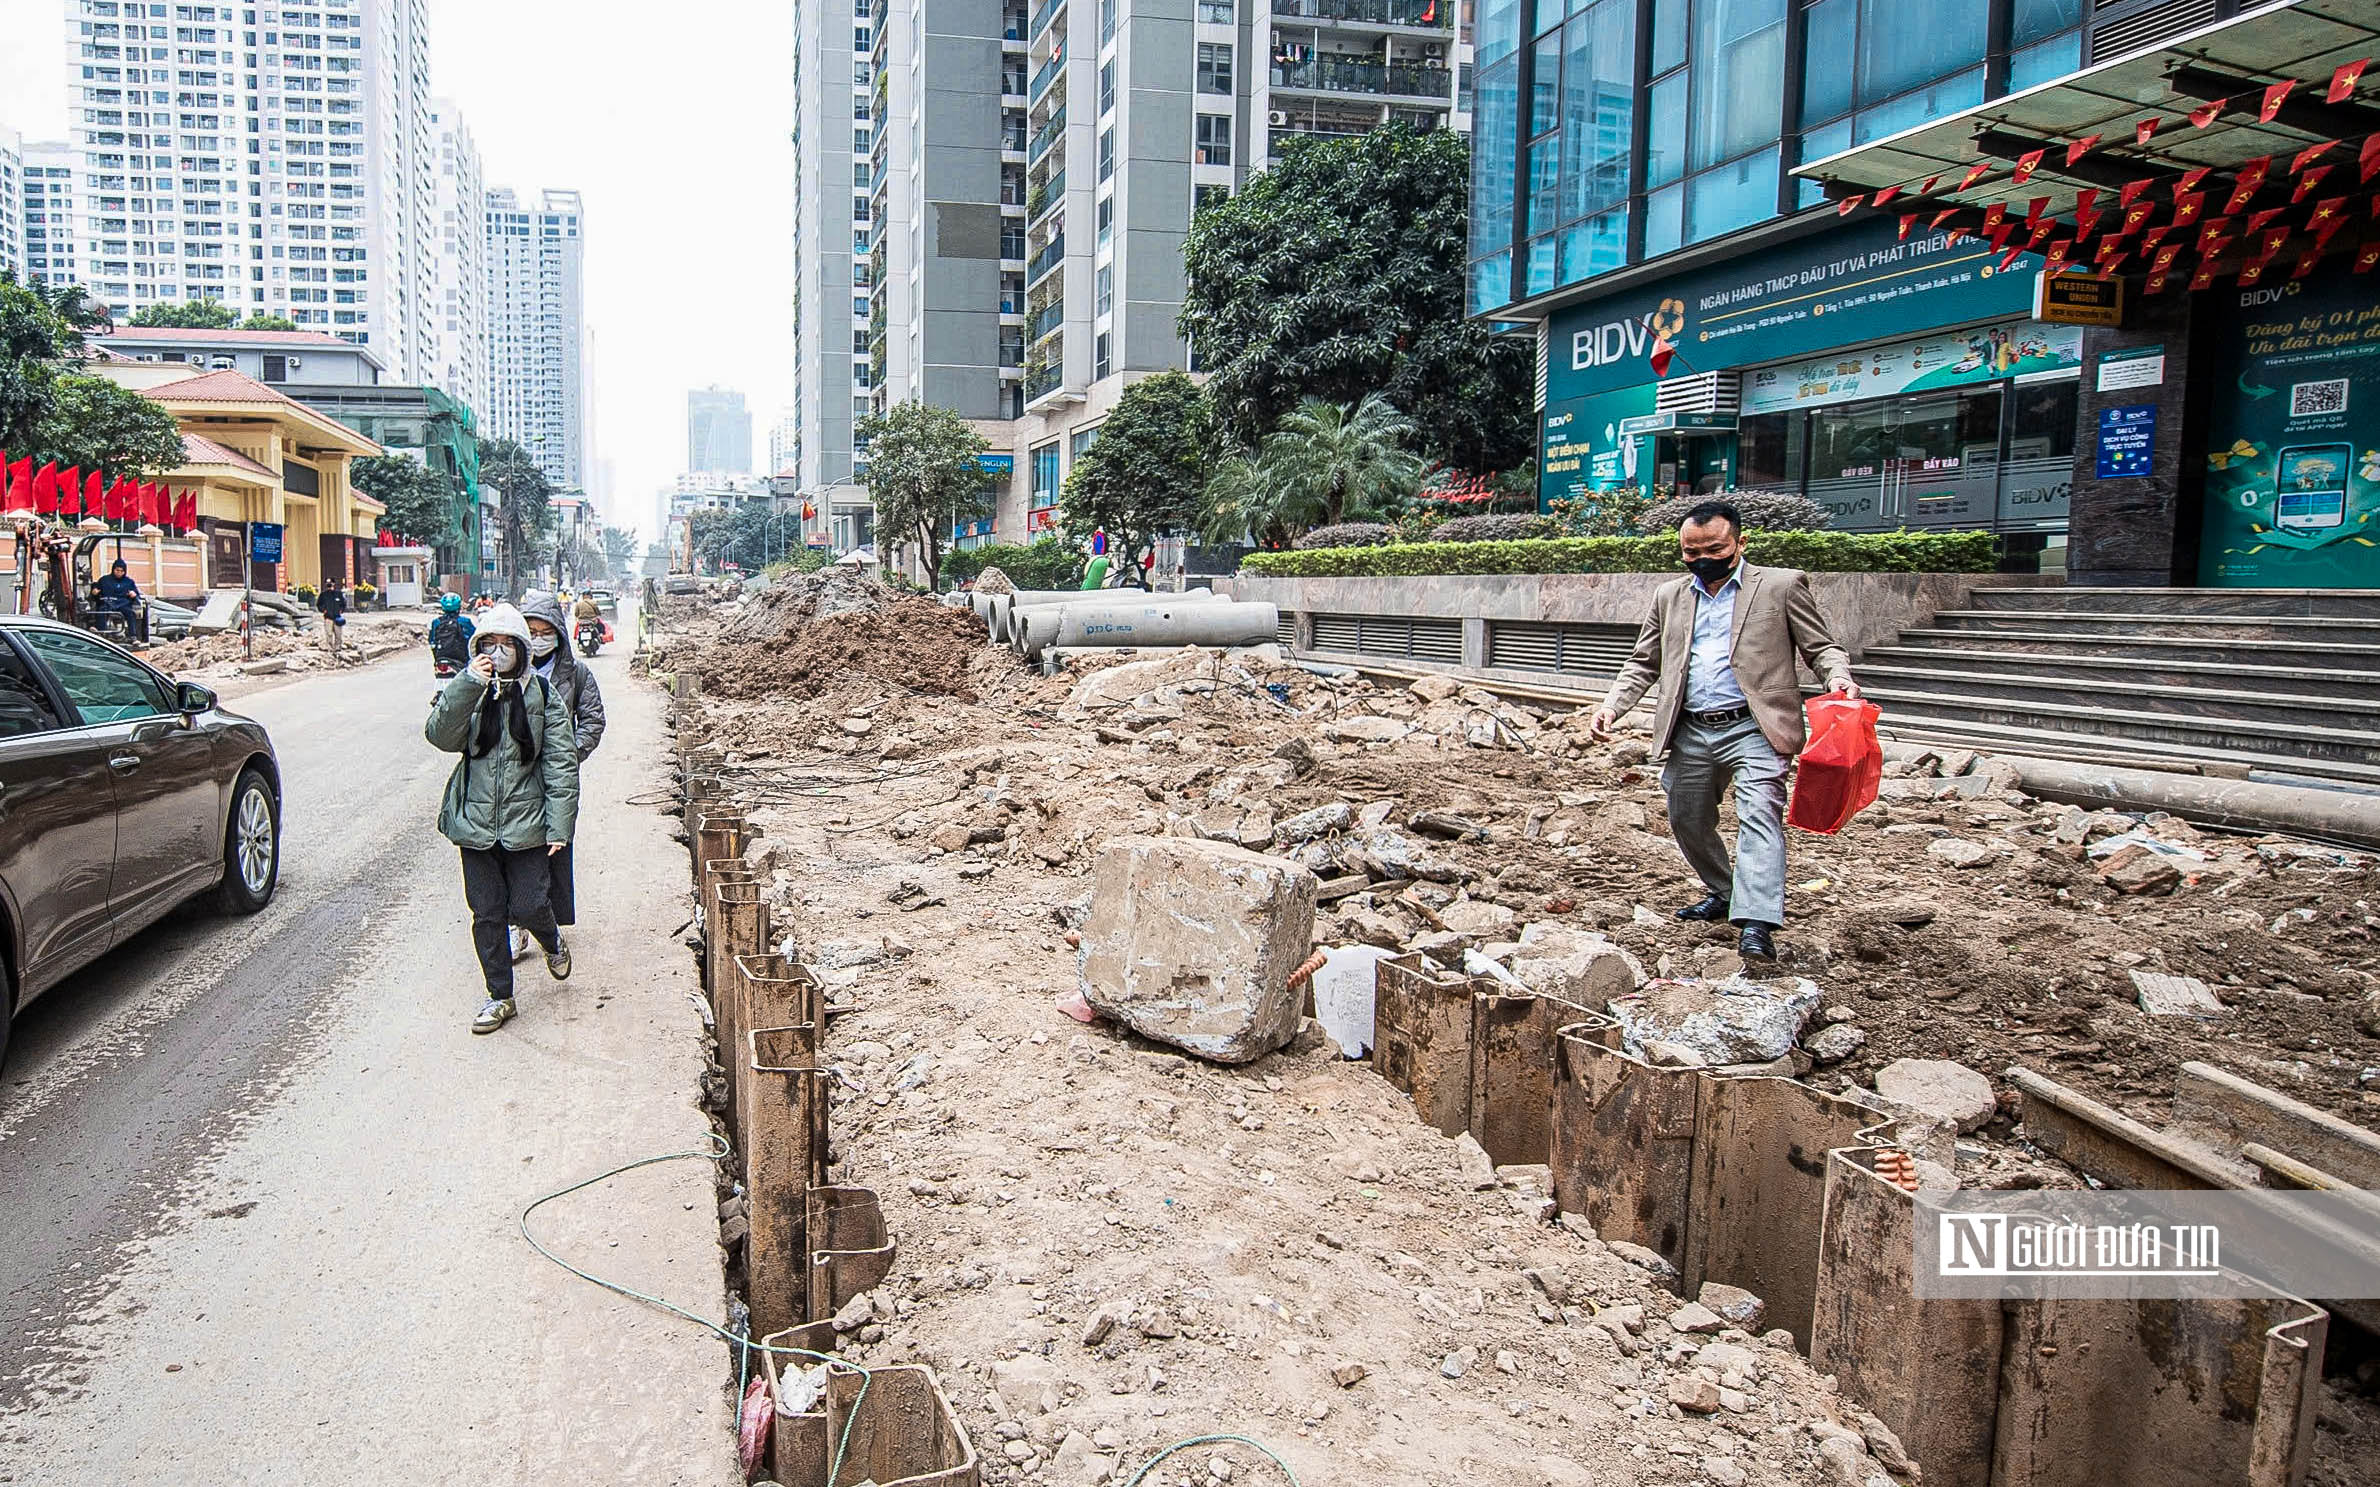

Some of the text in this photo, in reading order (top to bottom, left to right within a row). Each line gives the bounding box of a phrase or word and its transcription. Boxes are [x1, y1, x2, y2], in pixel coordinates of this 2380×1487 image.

[1700, 291, 1729, 311] NGÂN
[1731, 283, 1763, 303] HÀNG
[1765, 274, 1798, 293] TMCP
[1829, 258, 1848, 278] TƯ
[1849, 253, 1866, 272] VÀ
[1869, 244, 1906, 267] PHÁT
[2055, 281, 2099, 293] WESTERN
[2069, 292, 2099, 303] UNION
[2240, 287, 2284, 307] BIDV
[2247, 322, 2294, 338] Đăng
[2300, 314, 2324, 332] ký
[2330, 310, 2354, 325] 01
[1572, 312, 1654, 371] BIDV
[2280, 335, 2313, 350] đãi
[2316, 330, 2359, 346] trọn
[2012, 488, 2057, 506] BIDV
